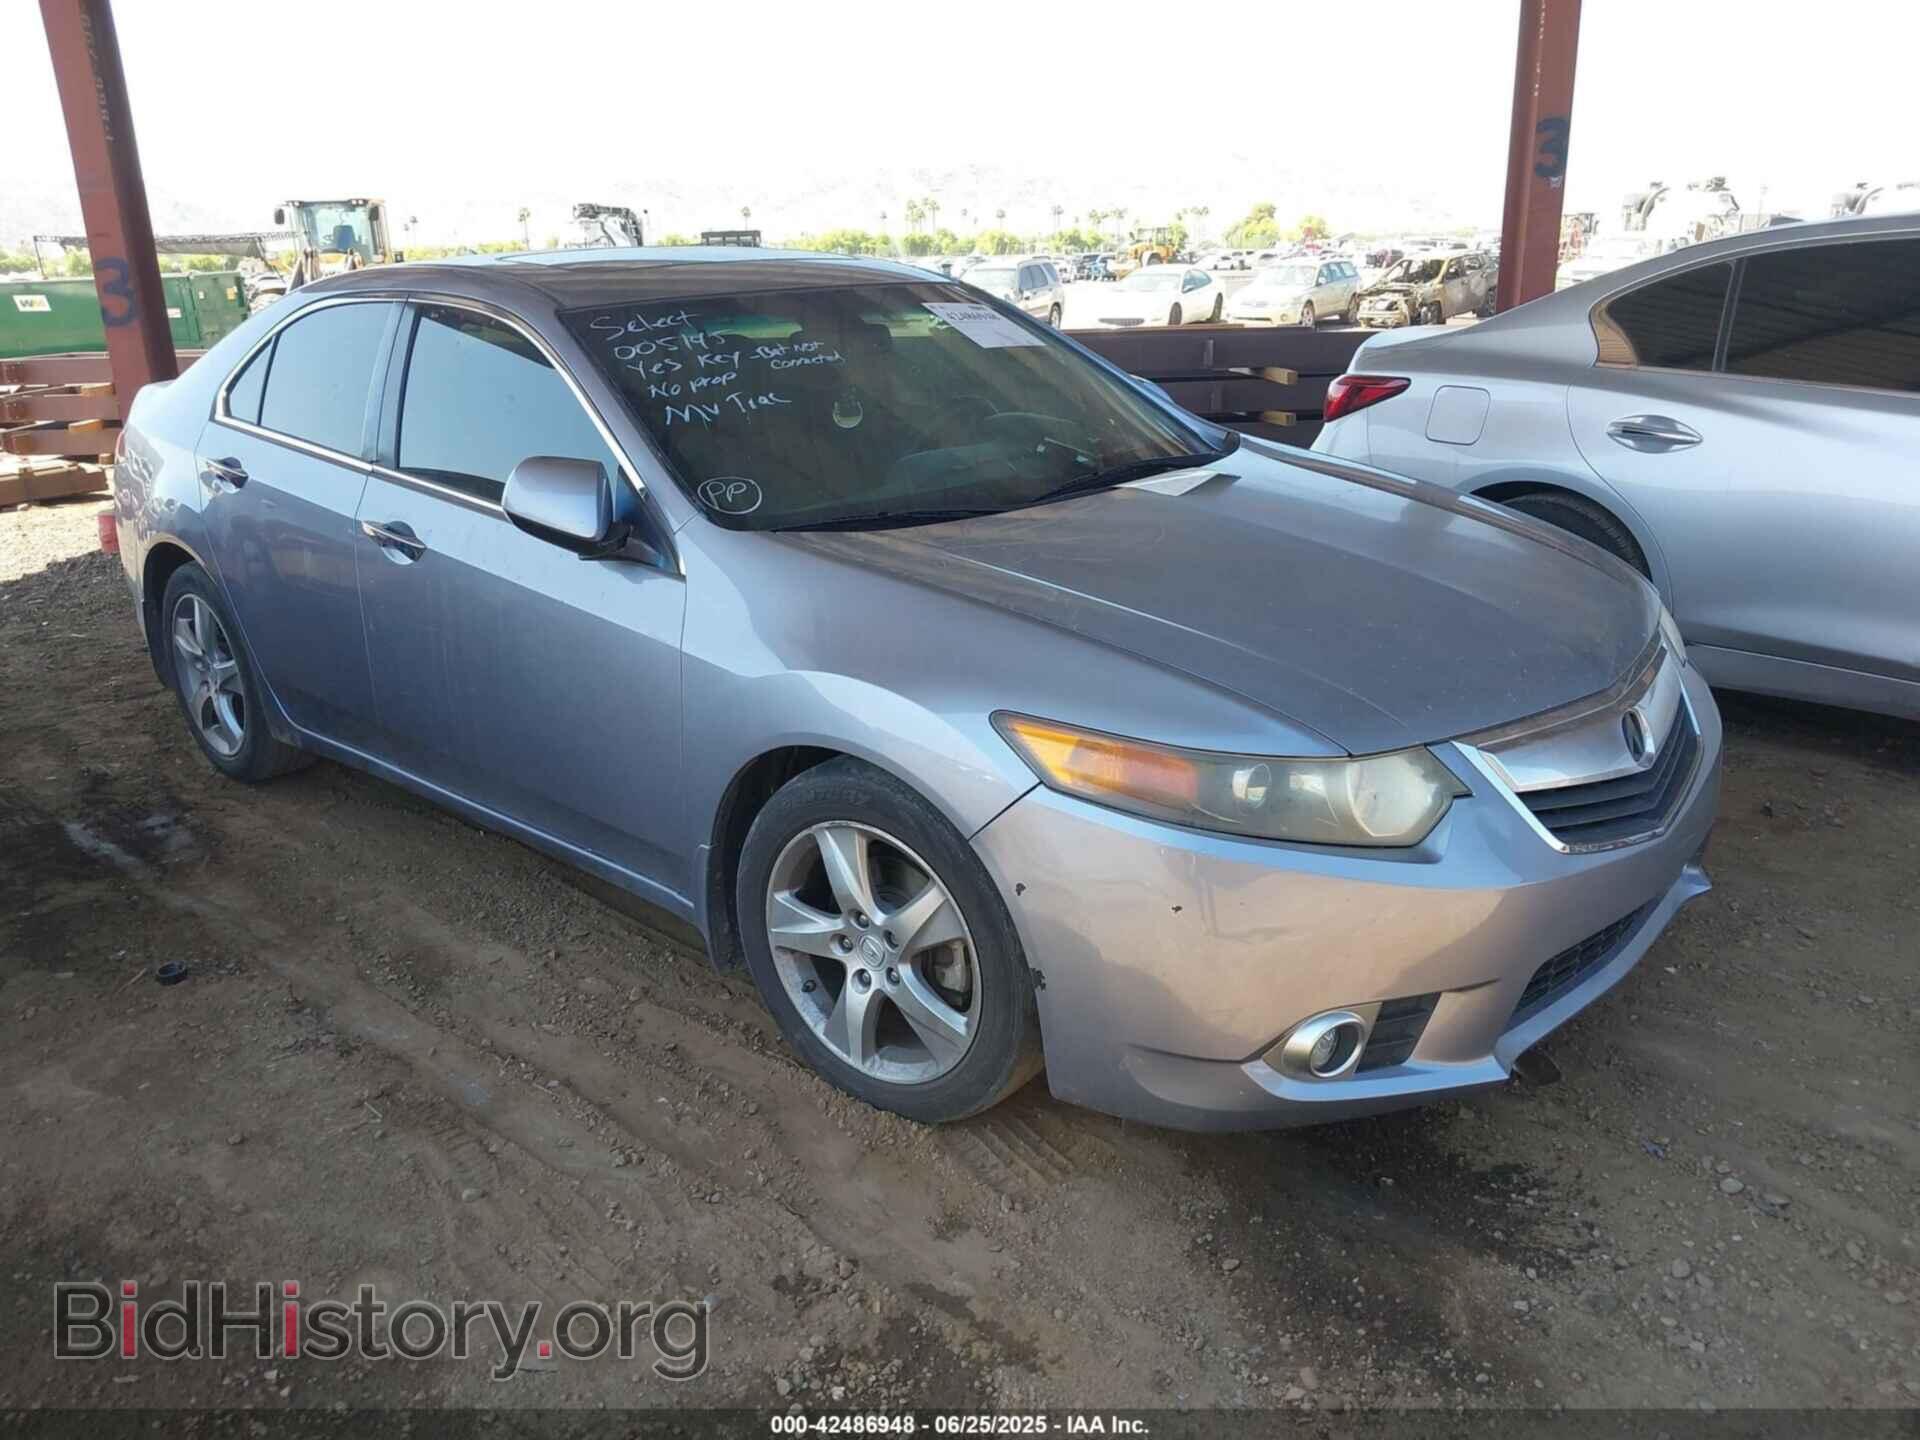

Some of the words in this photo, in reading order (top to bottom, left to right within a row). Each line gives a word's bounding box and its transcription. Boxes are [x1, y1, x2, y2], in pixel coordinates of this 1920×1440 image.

[1534, 116, 1569, 178] 3
[96, 255, 137, 327] 3
[590, 310, 701, 341] Select
[614, 328, 728, 360] 005145
[648, 382, 682, 398] No
